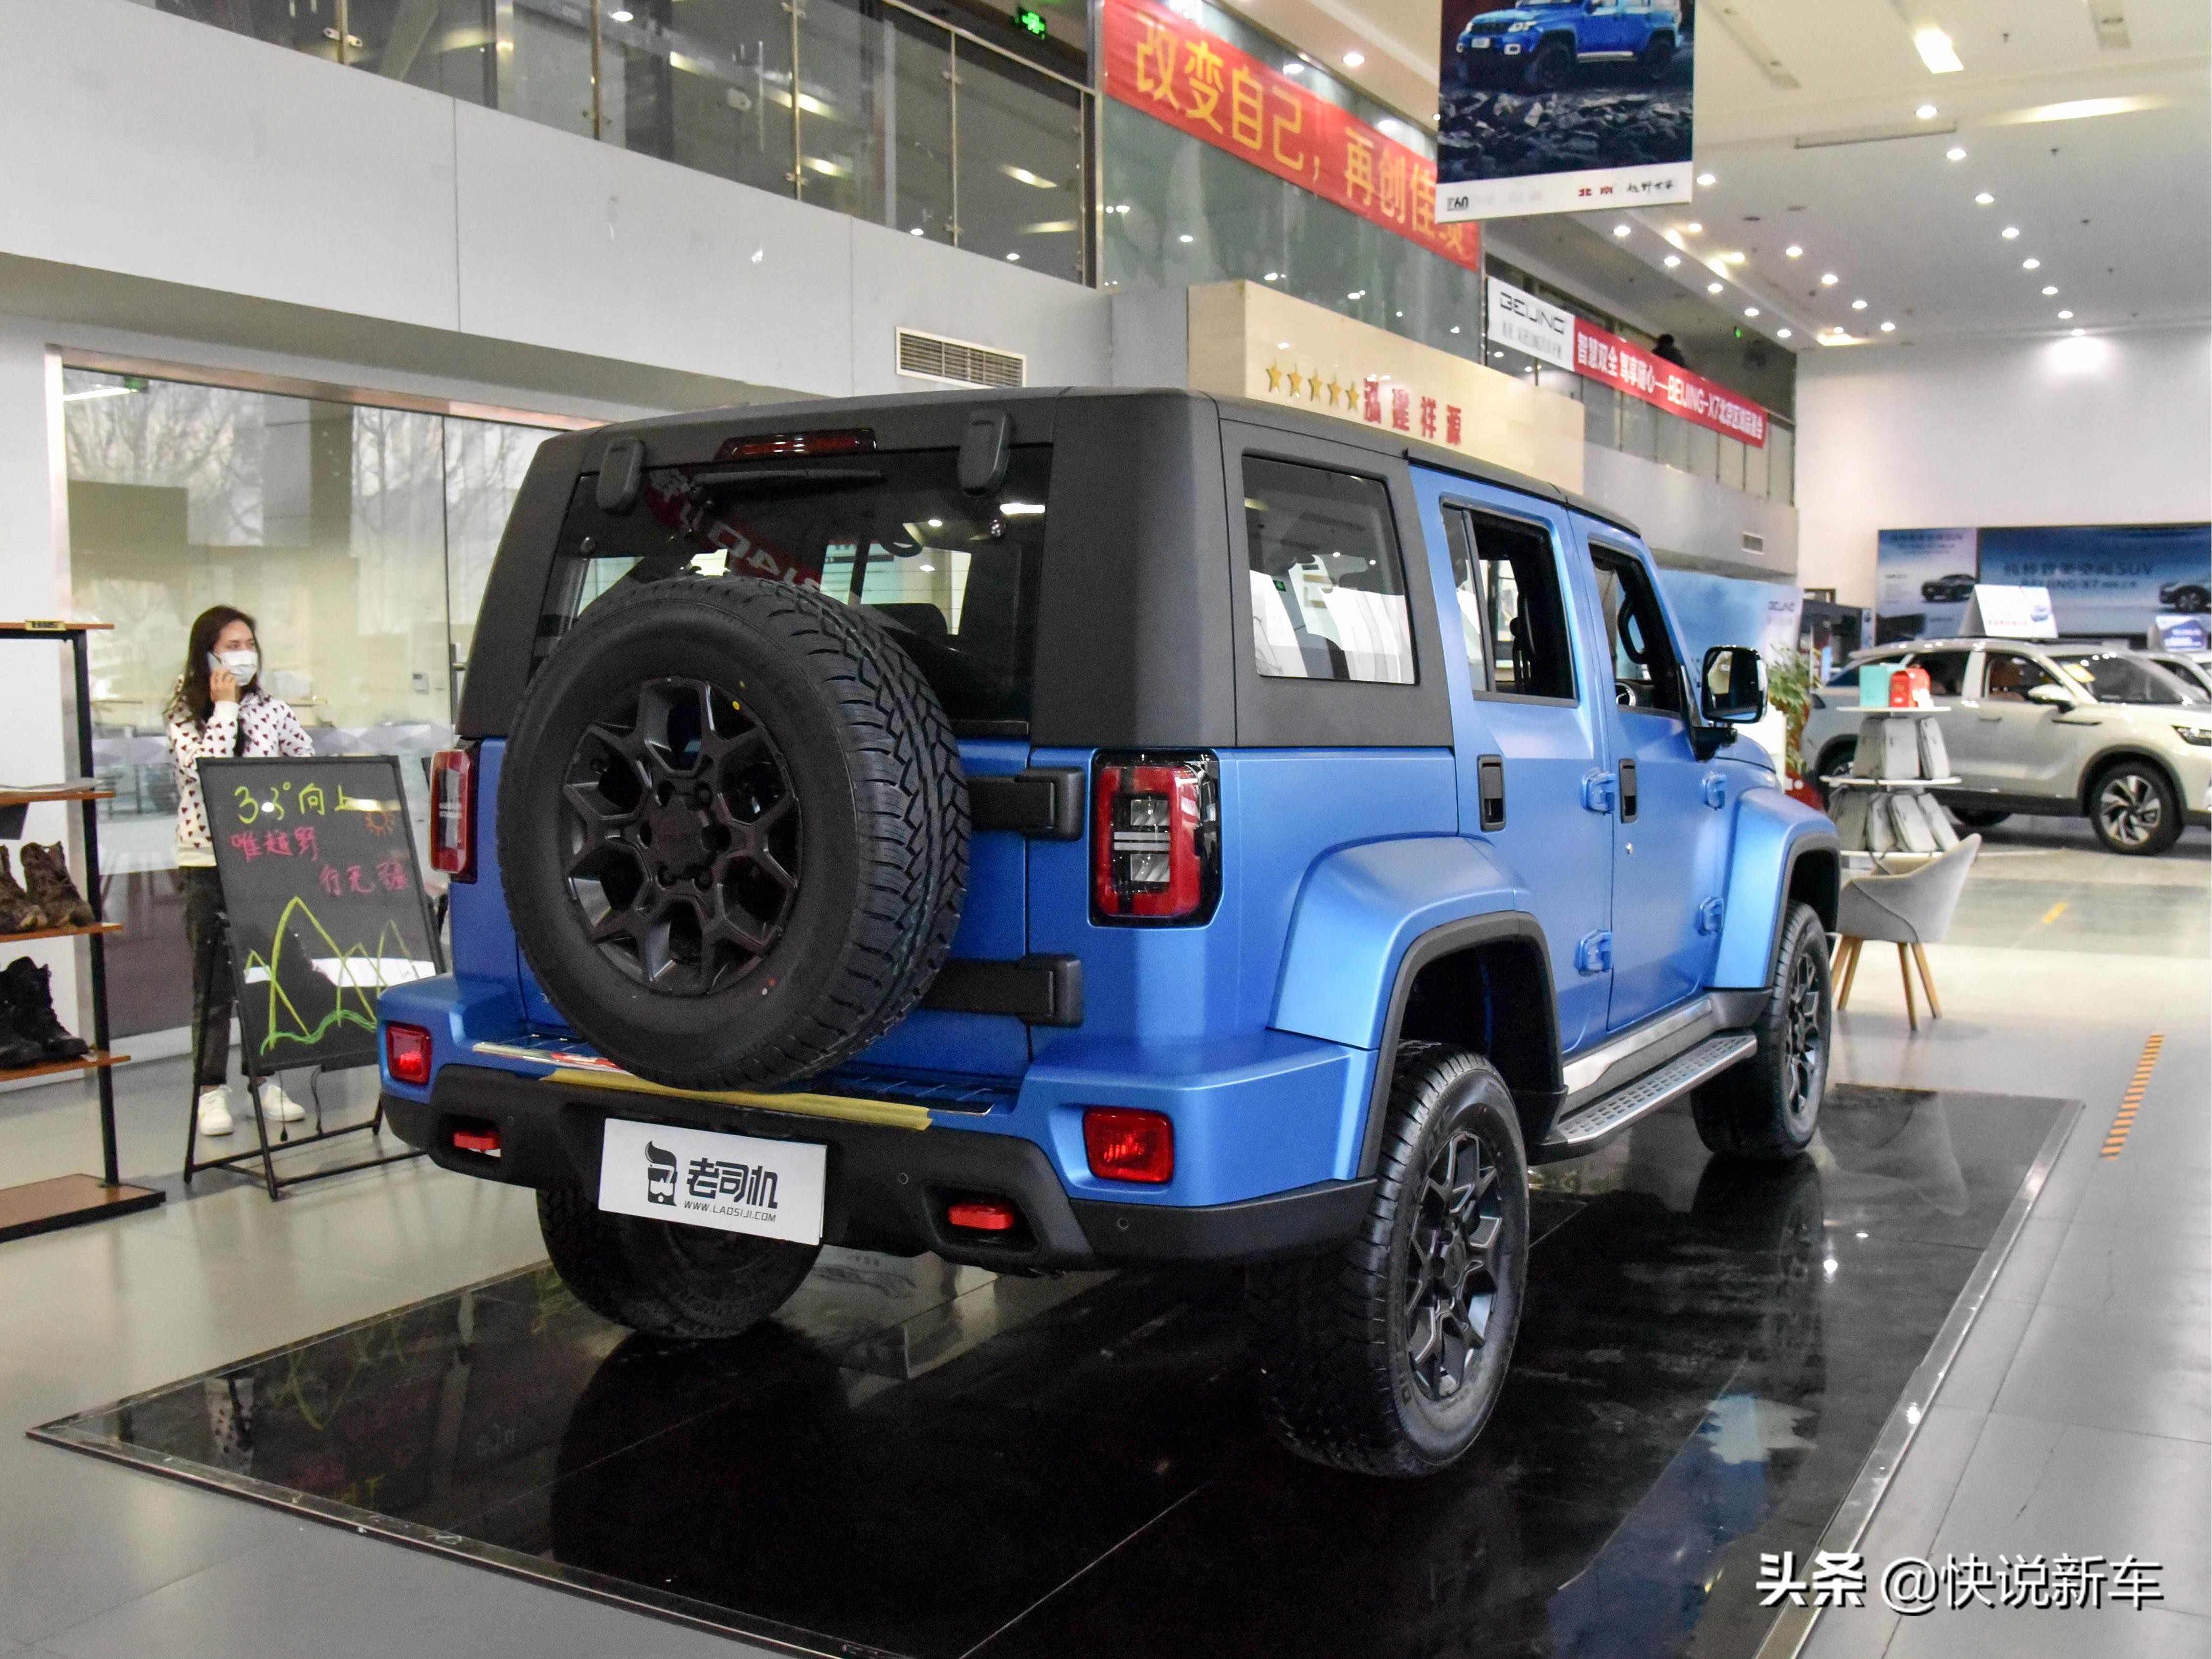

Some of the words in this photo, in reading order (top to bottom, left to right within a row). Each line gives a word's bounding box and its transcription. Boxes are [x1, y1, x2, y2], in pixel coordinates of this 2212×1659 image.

[1500, 291, 1565, 335] BEIJING
[686, 1157, 779, 1210] 老司机
[684, 1200, 777, 1223] WWW.LAOSIJI.COM
